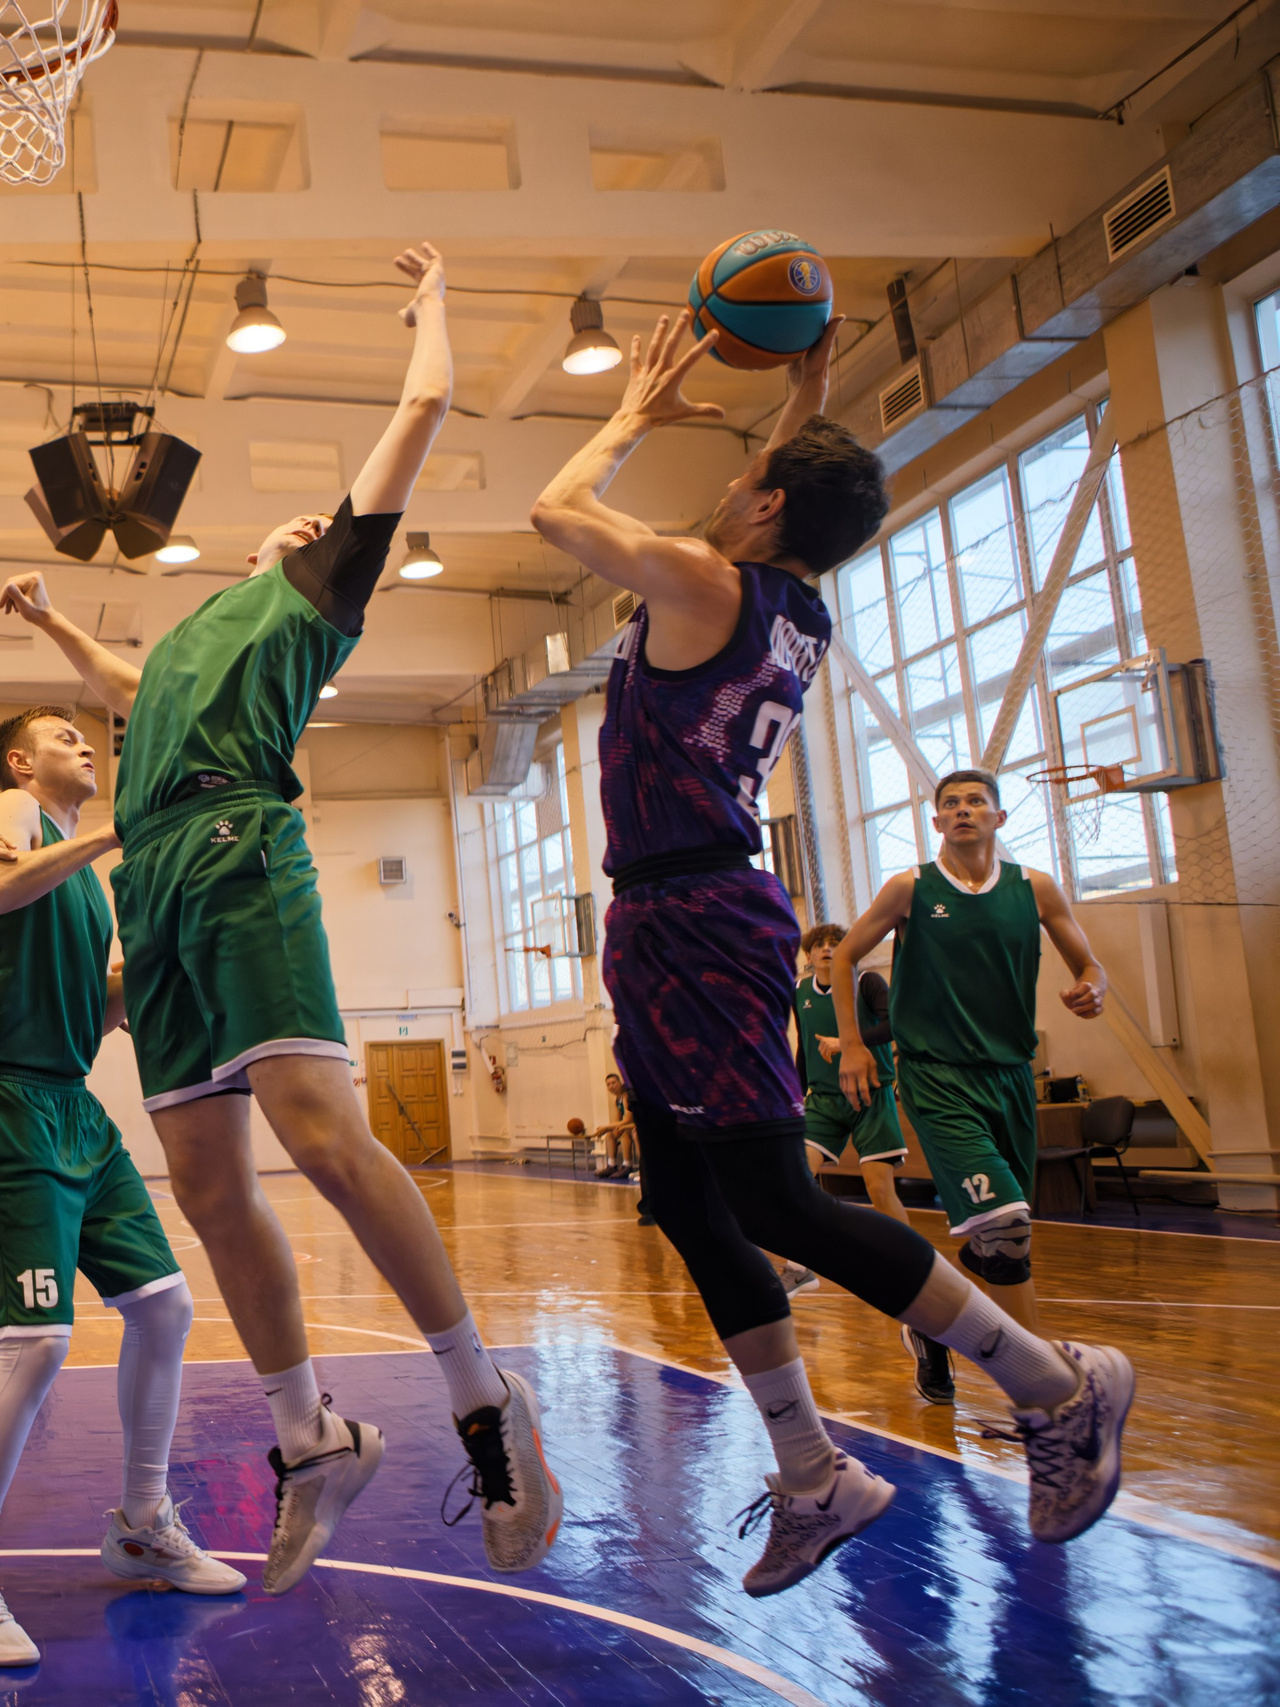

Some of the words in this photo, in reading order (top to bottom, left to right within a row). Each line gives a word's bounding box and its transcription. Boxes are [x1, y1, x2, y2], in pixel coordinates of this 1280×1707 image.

[210, 835, 240, 844] KELME
[961, 1173, 997, 1204] 12
[16, 1268, 59, 1309] 15
